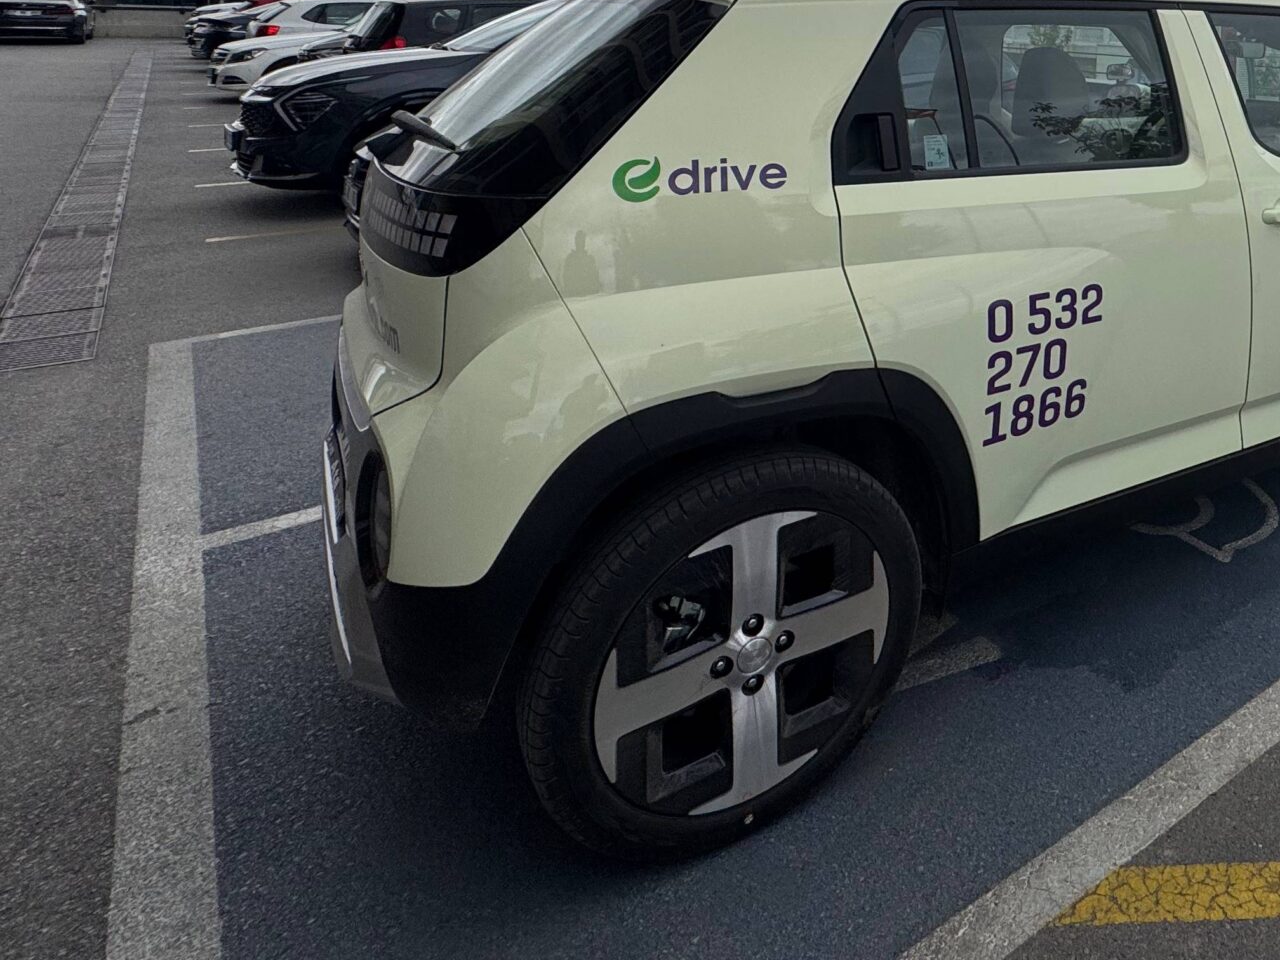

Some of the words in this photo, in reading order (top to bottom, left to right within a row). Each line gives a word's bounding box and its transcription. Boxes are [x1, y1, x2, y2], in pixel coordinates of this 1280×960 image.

[1027, 284, 1103, 336] 532
[986, 338, 1067, 396] 270
[982, 378, 1088, 448] 1866
